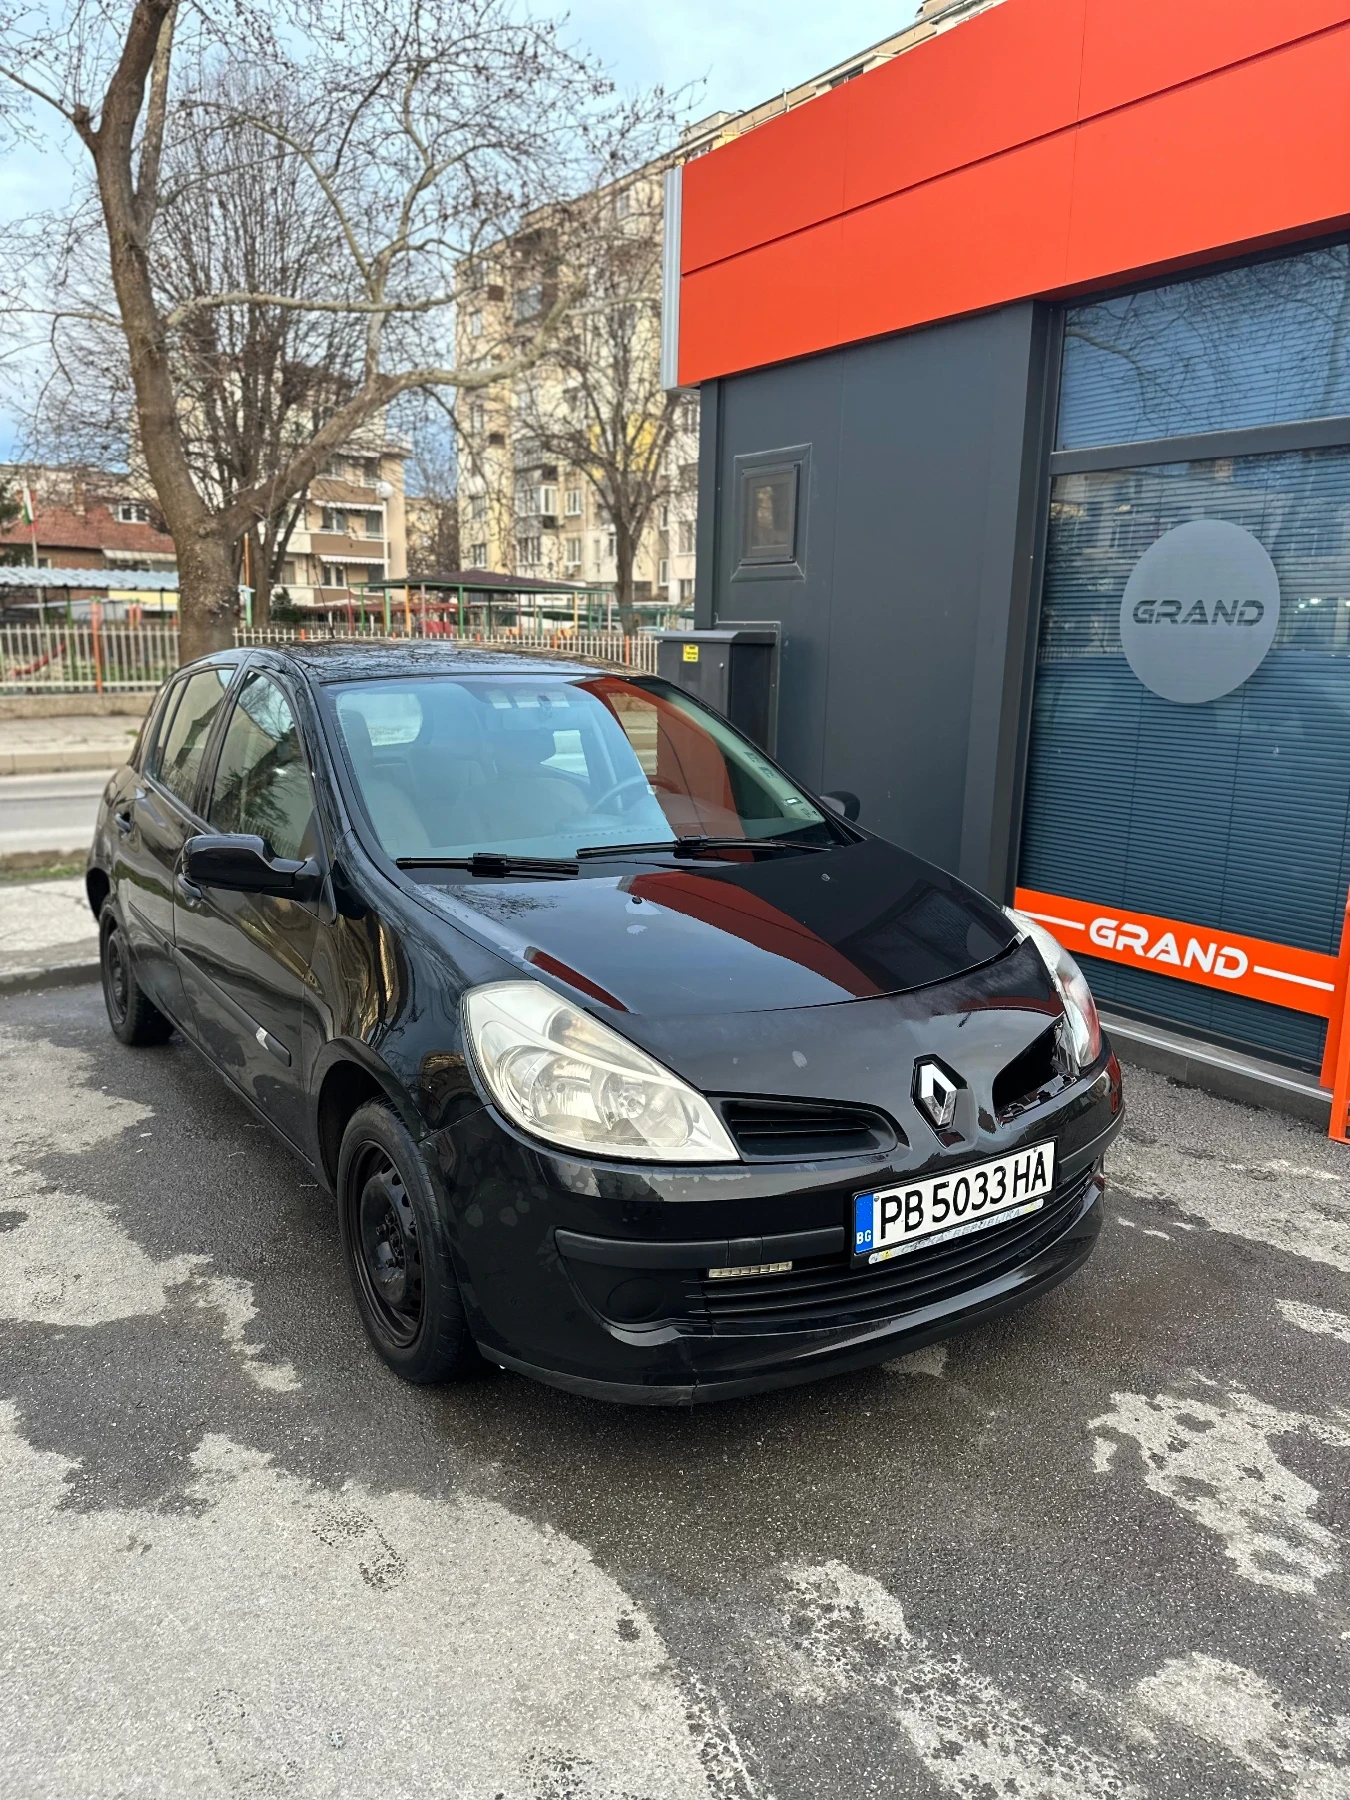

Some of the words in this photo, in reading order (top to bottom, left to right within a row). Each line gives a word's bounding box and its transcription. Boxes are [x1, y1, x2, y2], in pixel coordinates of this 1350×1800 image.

[1132, 599, 1265, 627] GRAND
[1089, 917, 1248, 979] GRAND
[880, 1189, 924, 1240] PB
[931, 1165, 1007, 1223] 5033
[1012, 1150, 1047, 1198] HA
[856, 1229, 872, 1245] BG
